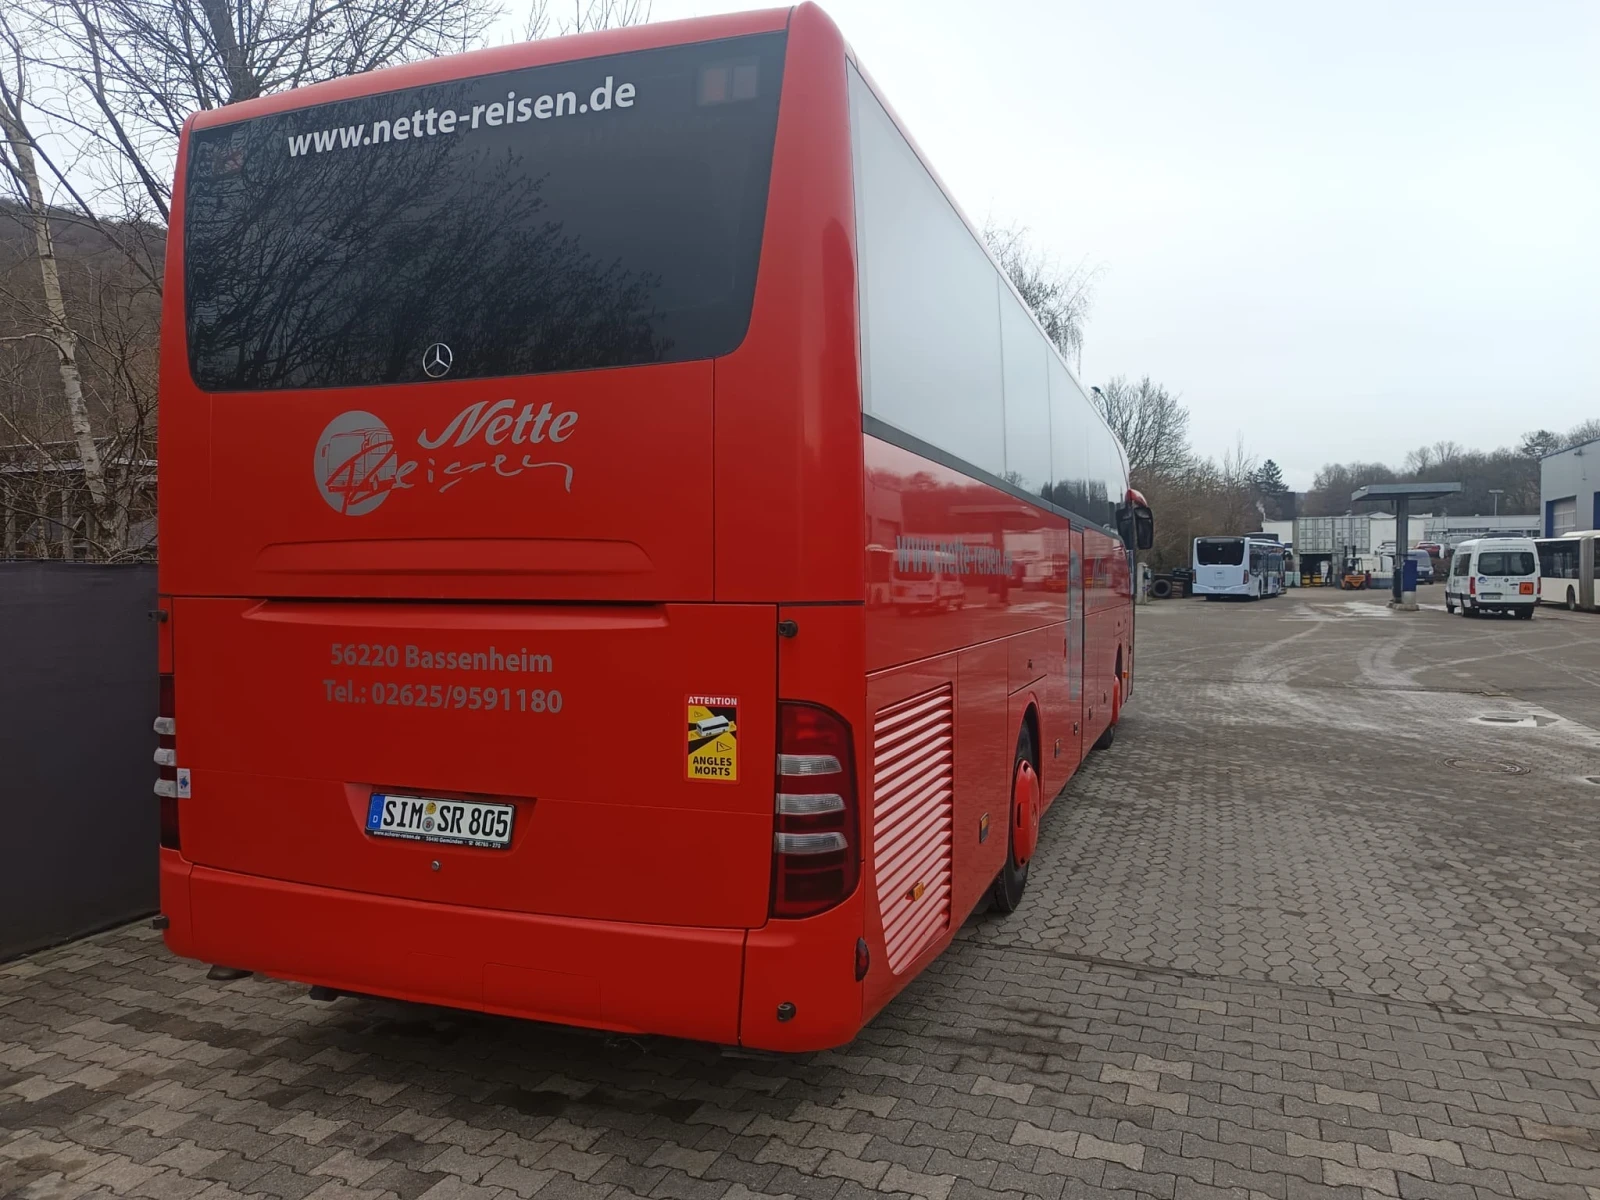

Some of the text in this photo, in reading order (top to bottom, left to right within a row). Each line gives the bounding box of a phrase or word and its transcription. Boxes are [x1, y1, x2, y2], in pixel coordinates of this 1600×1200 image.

[288, 76, 636, 158] www.nette-reisen.de
[417, 399, 579, 449] Nette
[325, 440, 573, 514] Reisen
[896, 535, 1013, 576] www.nette-reisen.de
[330, 643, 553, 673] 56220 Bassenheim
[323, 679, 563, 714] Tel.: 02625/9591180
[688, 696, 737, 706] ATTENTION
[692, 756, 732, 767] ANGLES
[694, 766, 730, 776] MORTS
[383, 801, 510, 838] SIM SR 805
